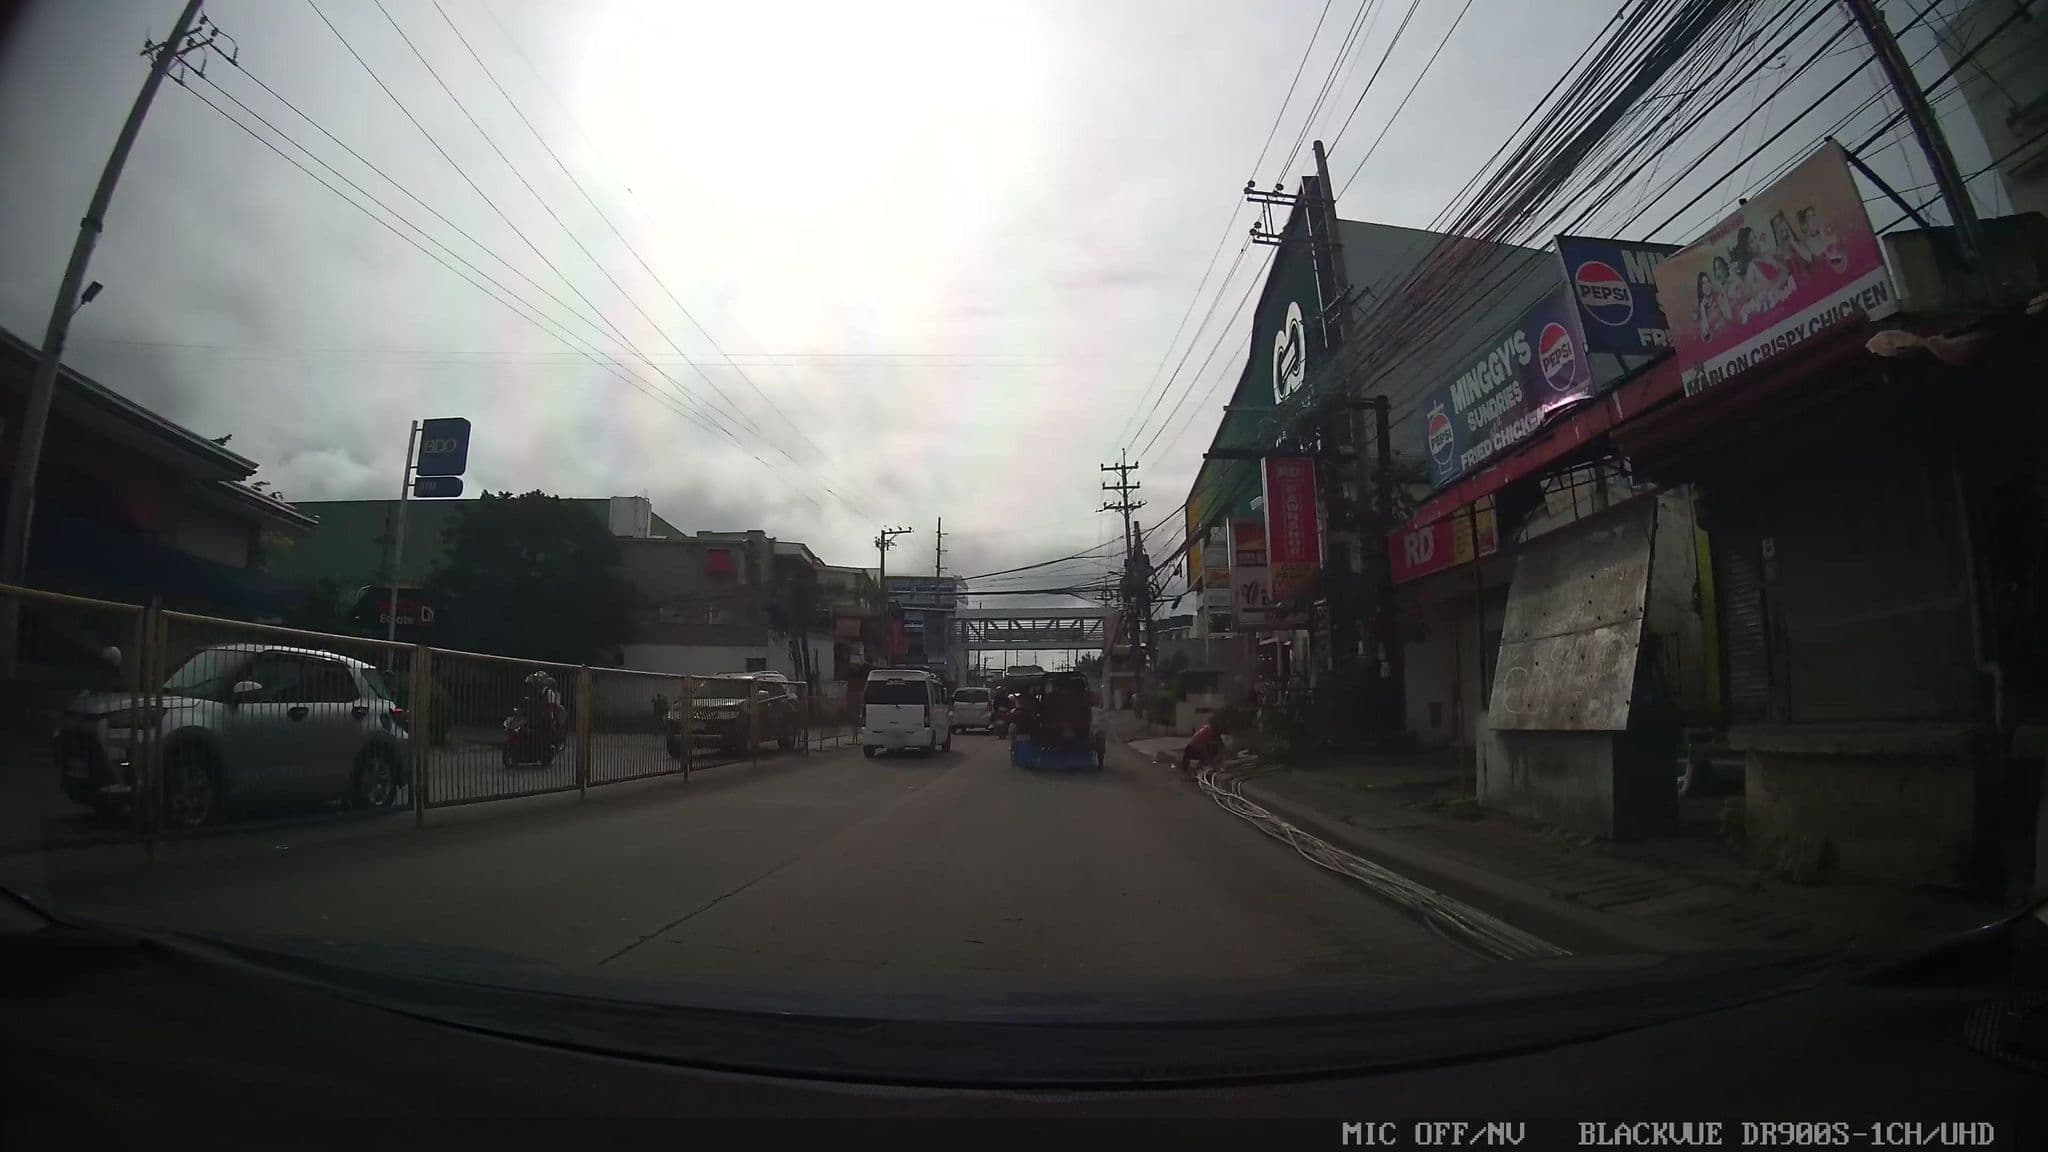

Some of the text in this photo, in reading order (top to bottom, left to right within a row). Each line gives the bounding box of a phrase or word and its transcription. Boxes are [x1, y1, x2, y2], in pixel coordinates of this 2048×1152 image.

[1621, 250, 1666, 285] MI
[1580, 284, 1629, 302] PEPSI
[1751, 324, 1806, 364] CRISPY
[1808, 281, 1888, 336] CHICKEN
[1450, 329, 1531, 414] MINGGY'S
[1542, 342, 1574, 372] PEPSI
[1467, 380, 1523, 431] SUNDRIES
[423, 438, 457, 454] BDO
[1431, 428, 1453, 450] PEPSI
[1460, 438, 1493, 471] FRIED
[1404, 525, 1435, 568] RD
